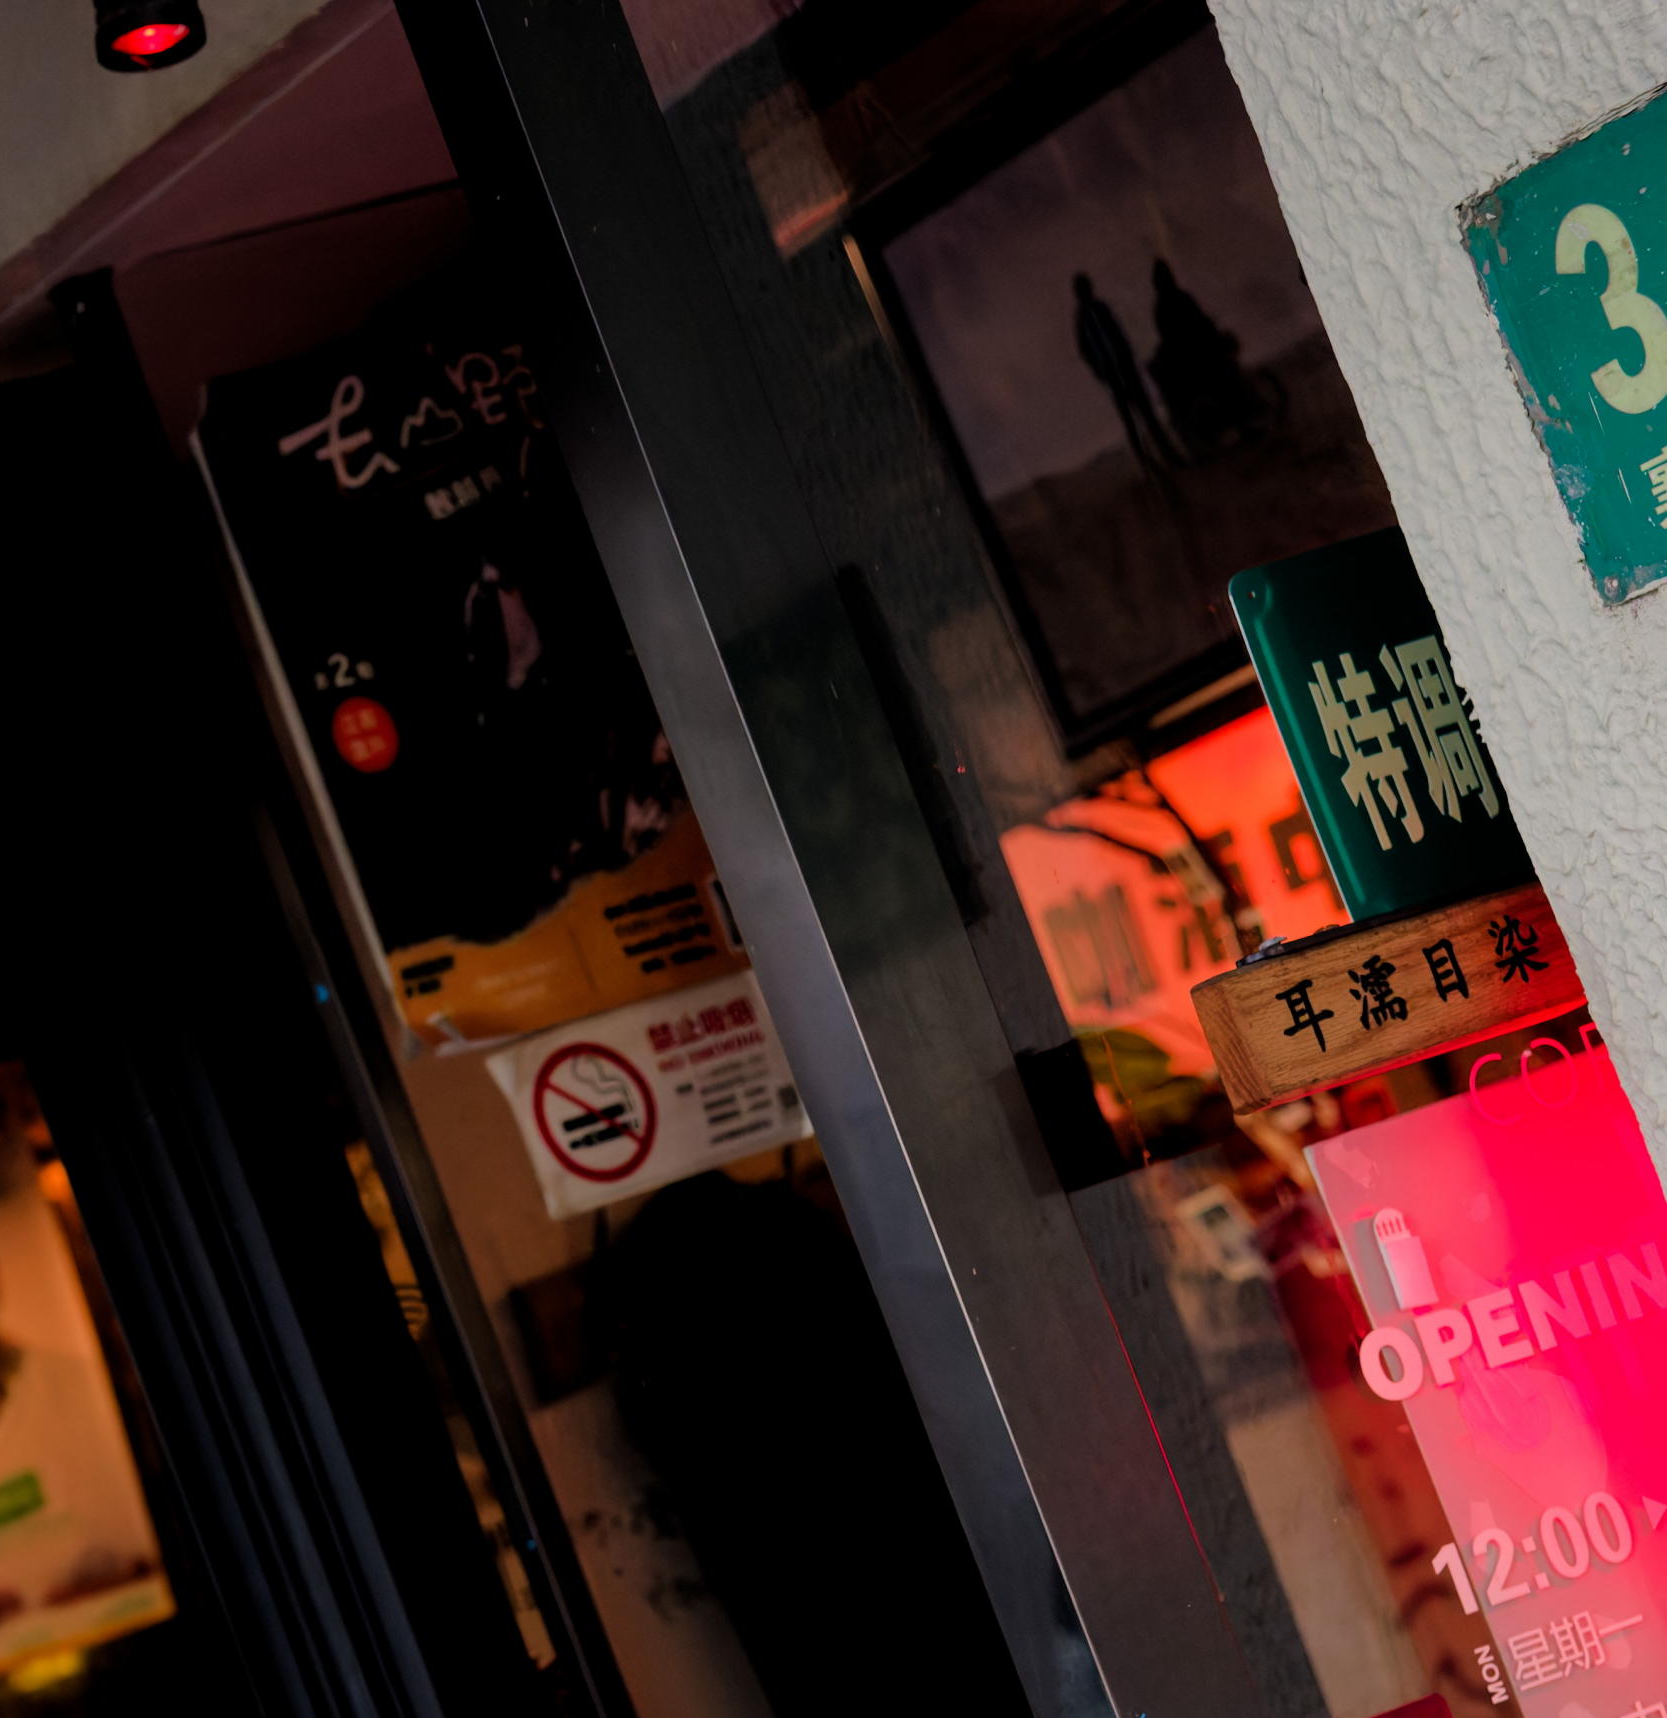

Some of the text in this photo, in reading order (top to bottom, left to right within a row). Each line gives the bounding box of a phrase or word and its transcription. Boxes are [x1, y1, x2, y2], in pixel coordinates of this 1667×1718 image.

[1555, 203, 1667, 414] 3
[1307, 634, 1501, 852] 特调
[1275, 914, 1551, 1053] 耳濡目染
[1469, 1021, 1604, 1126] CO
[1431, 1491, 1633, 1616] 12:00
[1507, 1610, 1644, 1692] 星期一
